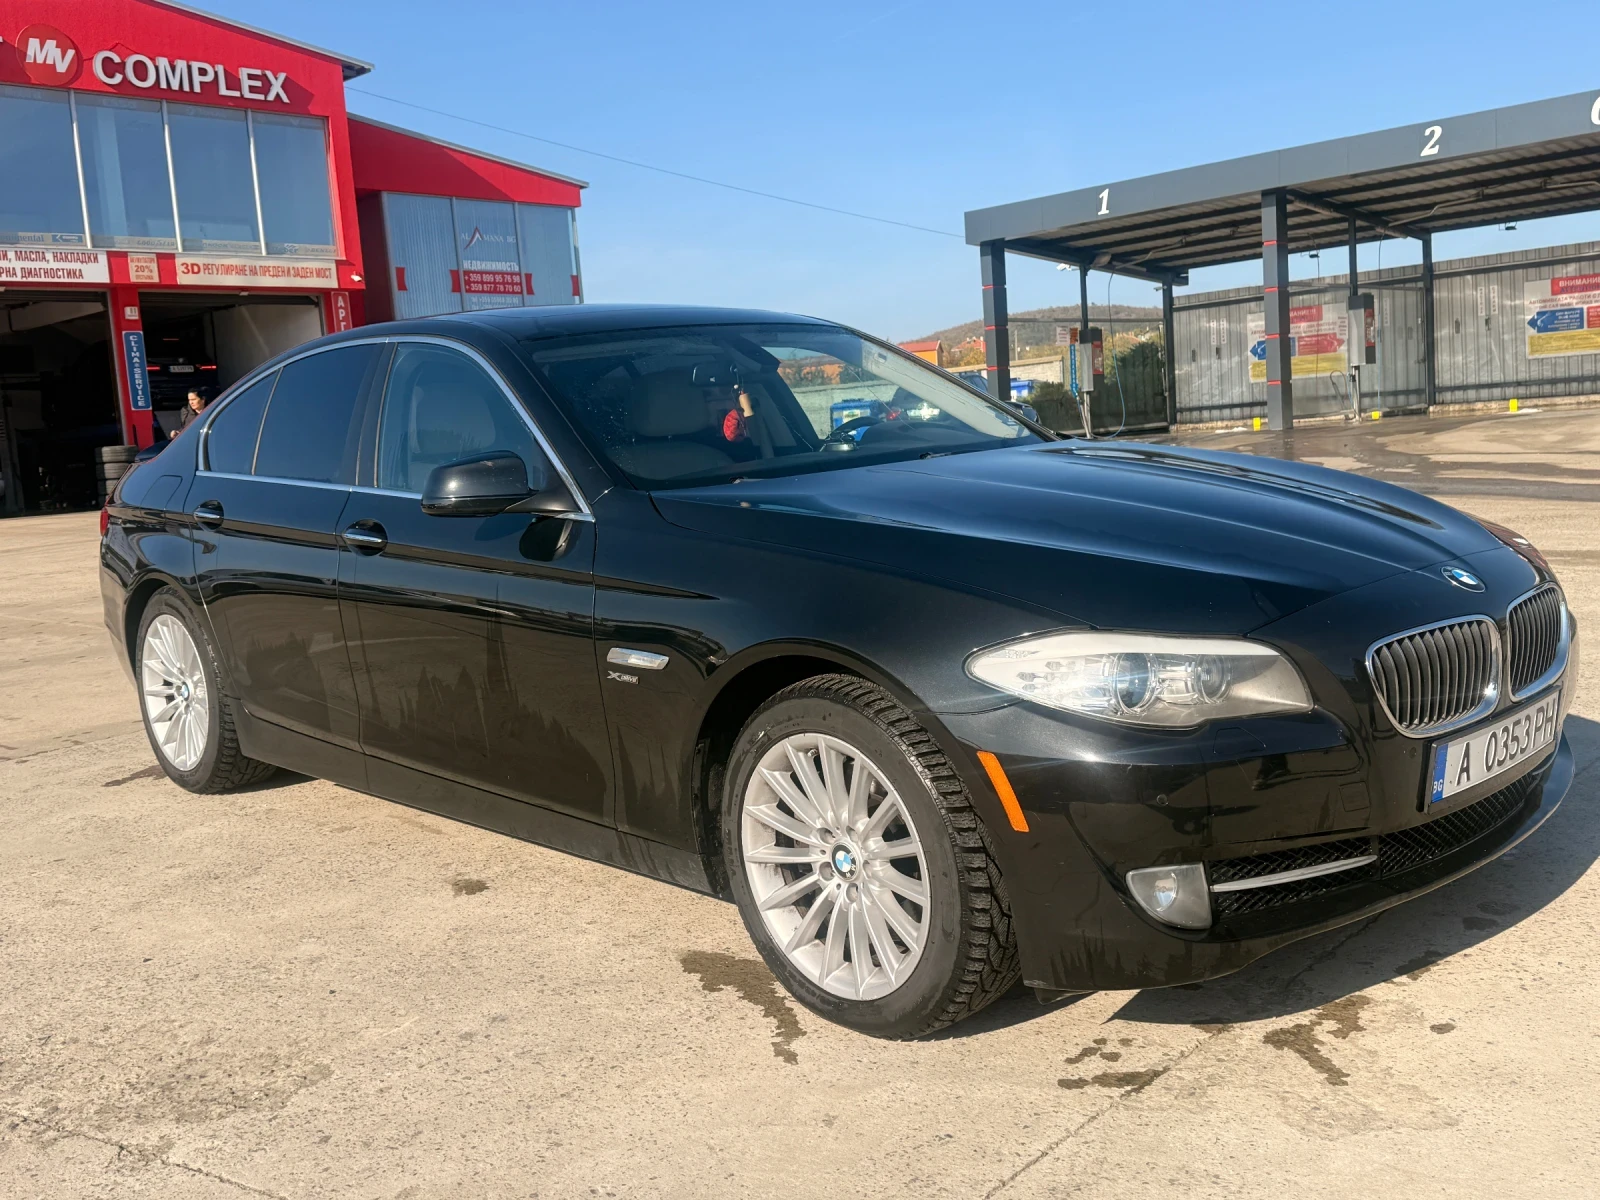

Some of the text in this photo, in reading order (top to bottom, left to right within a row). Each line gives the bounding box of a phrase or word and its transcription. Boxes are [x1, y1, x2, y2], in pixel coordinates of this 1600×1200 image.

[25, 37, 291, 104] MV COMPLEX
[1420, 125, 1443, 157] 2
[1097, 188, 1110, 216] 1
[14, 250, 50, 264] МАСЛА,
[52, 251, 99, 265] НАКЛАДКИ
[20, 267, 84, 279] ДИАГНОСТИКА
[134, 264, 153, 273] 20%
[181, 262, 201, 275] 3D
[202, 263, 248, 276] РЕГУЛИРАНЕ
[249, 265, 259, 277] НА
[260, 265, 286, 279] ПРЕДЕН
[292, 266, 314, 279] ЗАДЕН
[315, 267, 332, 279] МОСТ
[1432, 779, 1444, 794] BG
